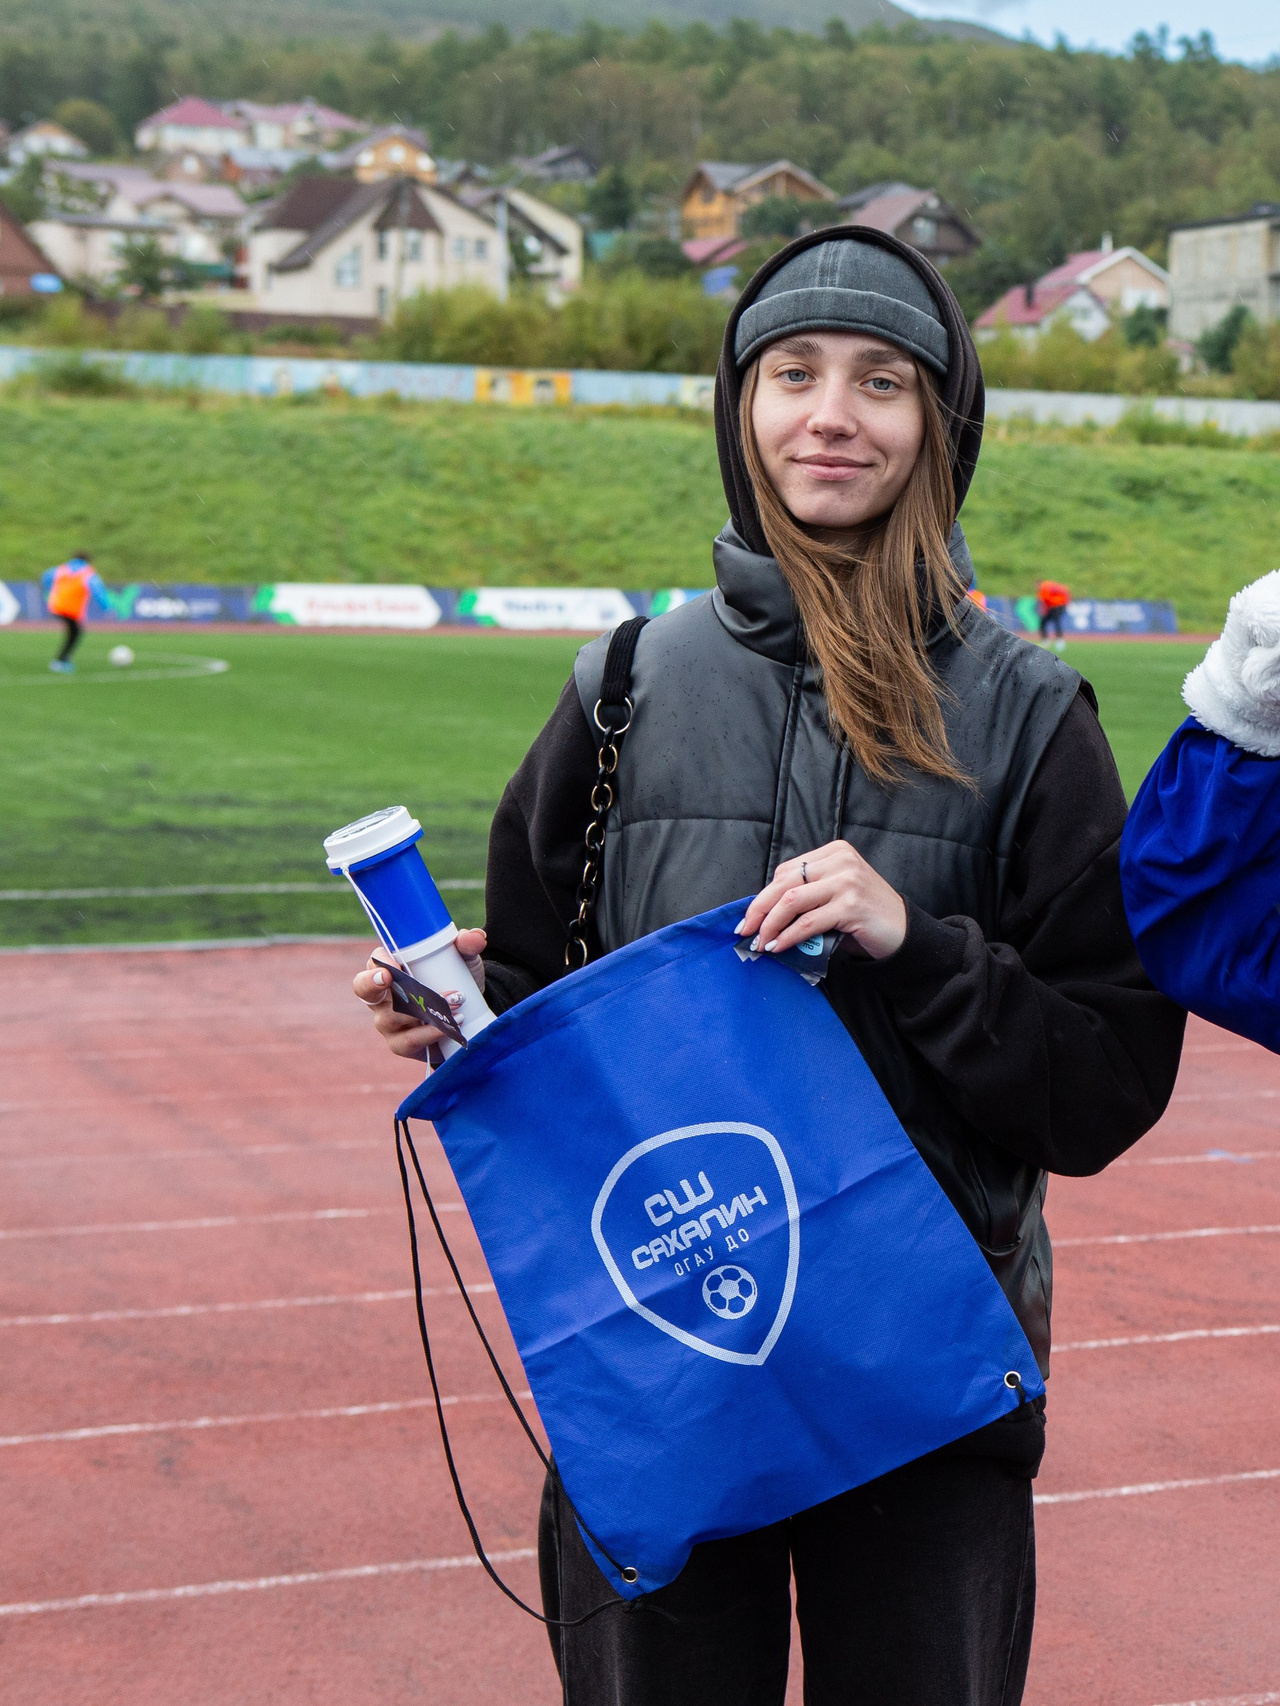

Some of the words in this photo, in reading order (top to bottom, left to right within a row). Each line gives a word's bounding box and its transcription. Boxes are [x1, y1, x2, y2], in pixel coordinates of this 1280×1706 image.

[644, 1171, 714, 1227] СШ
[631, 1185, 768, 1270] САХАЛИН
[674, 1245, 714, 1276] ОГАУ
[725, 1228, 750, 1252] ДО
